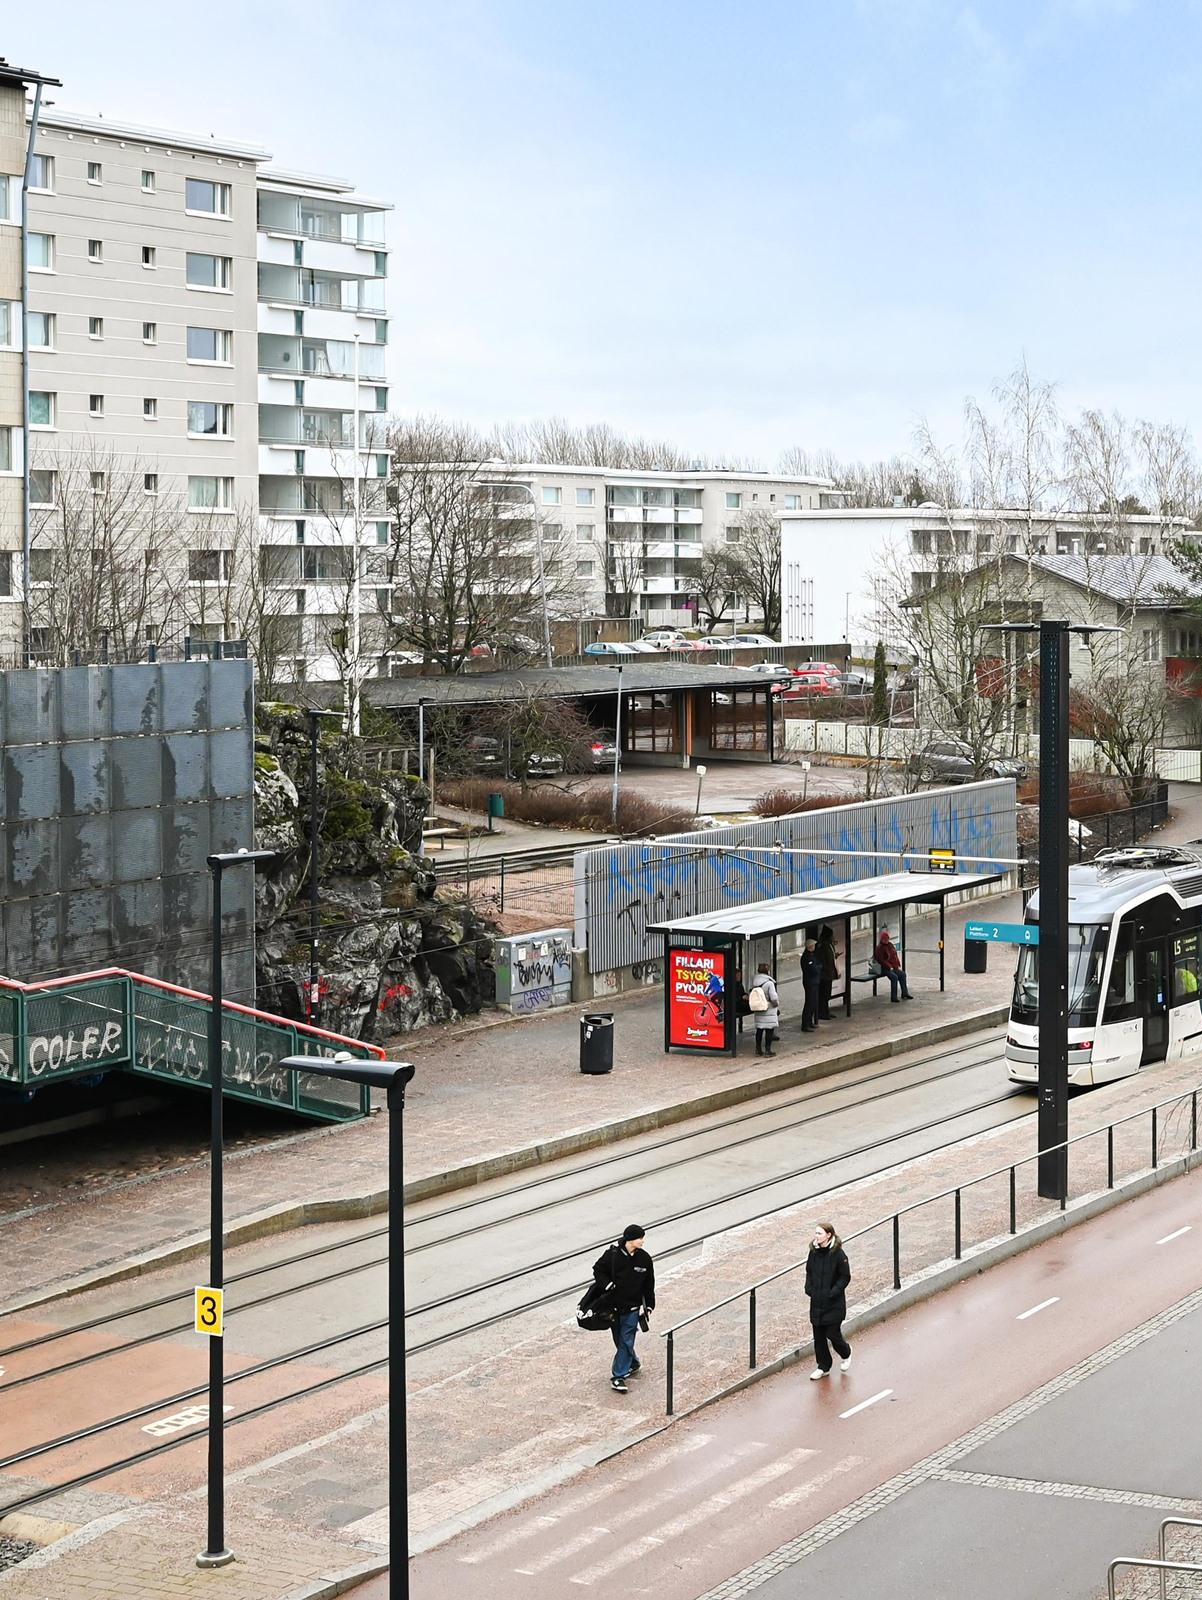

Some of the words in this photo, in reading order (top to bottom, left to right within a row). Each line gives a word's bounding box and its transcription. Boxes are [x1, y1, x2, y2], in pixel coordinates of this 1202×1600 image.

[992, 927, 999, 938] 2
[675, 956, 714, 969] FILLARI
[29, 1021, 122, 1076] COLER
[200, 1296, 217, 1326] 3
